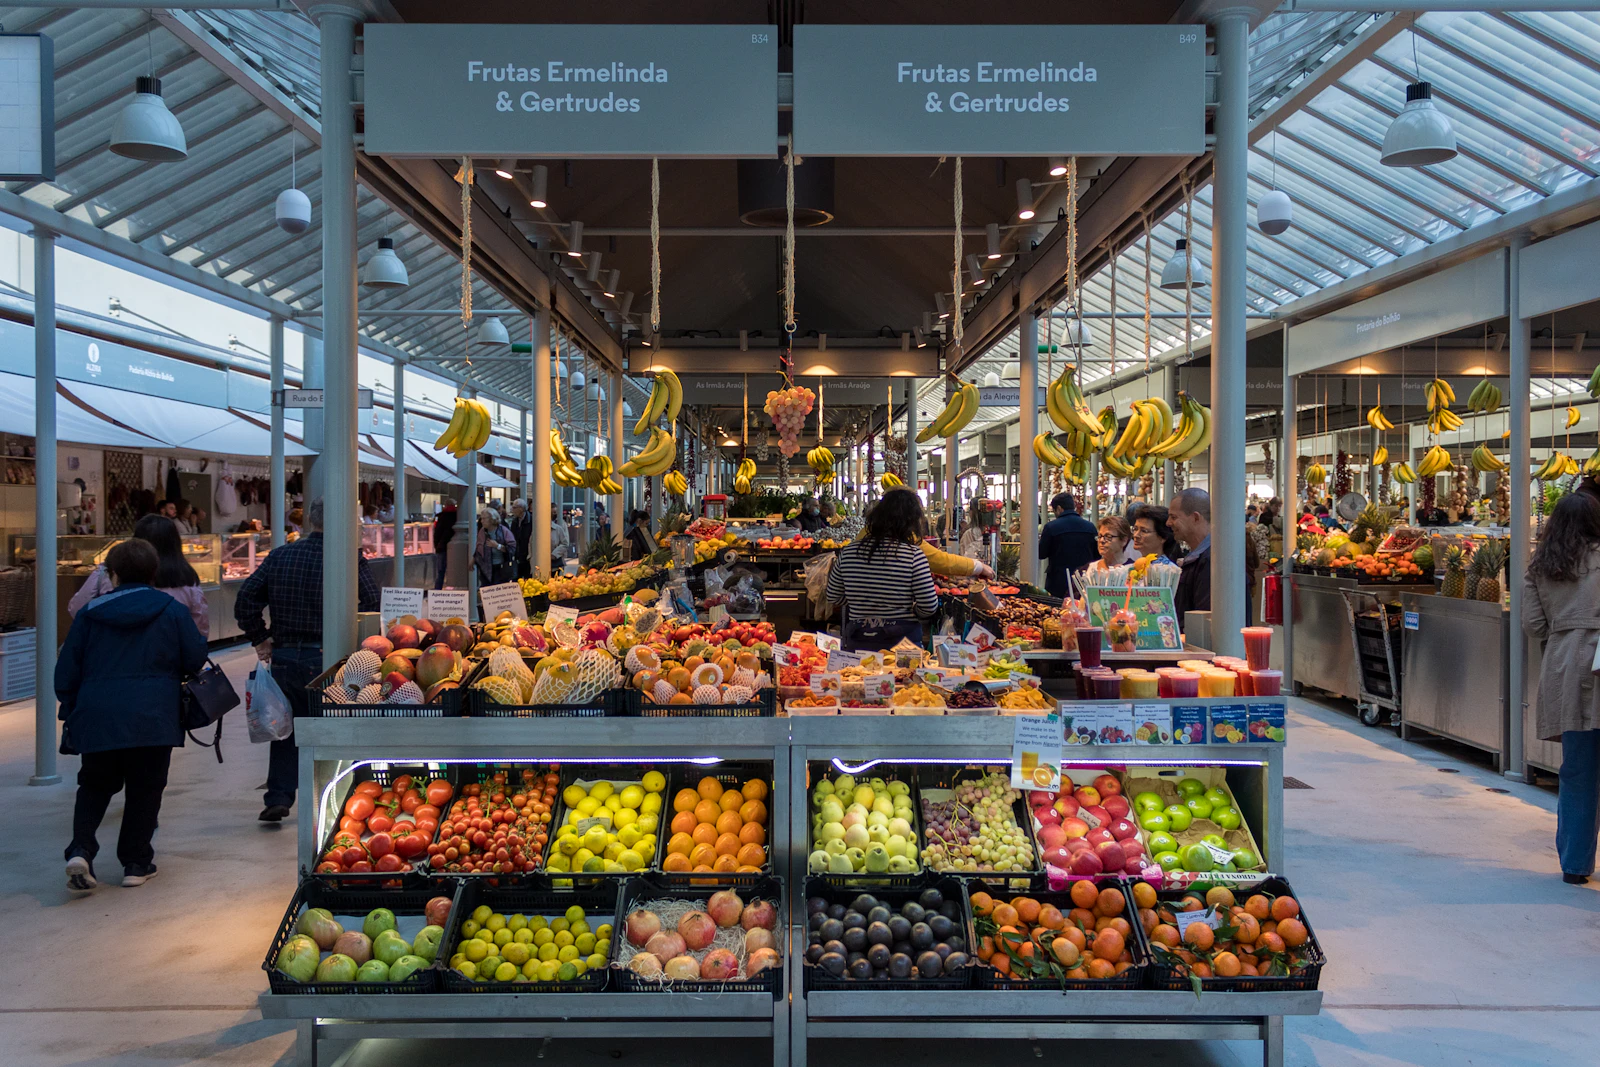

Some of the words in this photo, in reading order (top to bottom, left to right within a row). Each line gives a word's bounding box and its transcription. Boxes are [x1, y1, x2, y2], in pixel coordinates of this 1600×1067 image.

[752, 34, 768, 44] B34
[1180, 34, 1197, 44] B49
[469, 62, 540, 81] Frutas
[549, 62, 667, 82] Ermelinda
[899, 63, 970, 82] Frutas
[978, 62, 1096, 82] Ermelinda
[496, 91, 513, 111] &
[520, 91, 640, 112] Gertrudes
[926, 92, 943, 112] &
[950, 92, 1069, 112] Gertrudes
[1356, 320, 1375, 333] Frutaria
[1376, 318, 1382, 327] do
[1383, 312, 1400, 325] Bolhão
[994, 393, 1020, 401] Alegria
[1136, 589, 1160, 597] Juices
